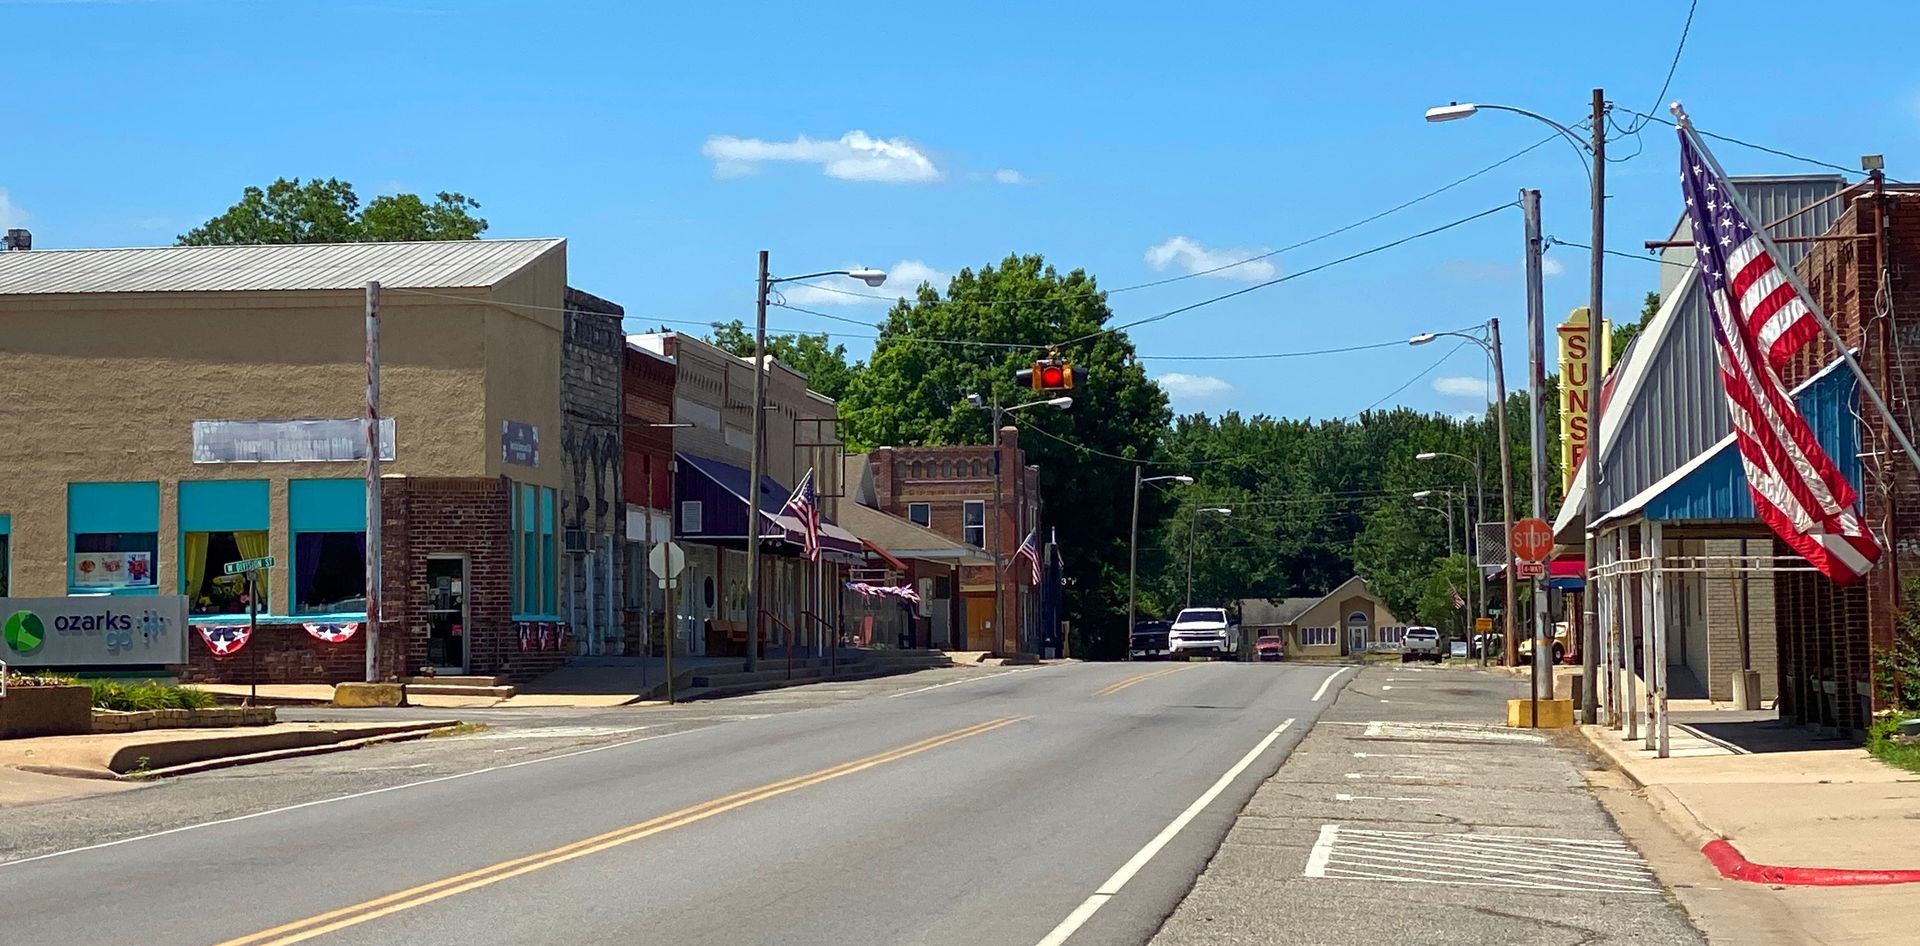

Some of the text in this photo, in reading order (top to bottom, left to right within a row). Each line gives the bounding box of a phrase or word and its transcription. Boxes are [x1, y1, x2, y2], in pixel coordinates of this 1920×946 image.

[1514, 532, 1550, 548] STOP
[1523, 565, 1542, 574] 4-WAY
[55, 609, 132, 631] ozarks
[106, 631, 130, 651] go
